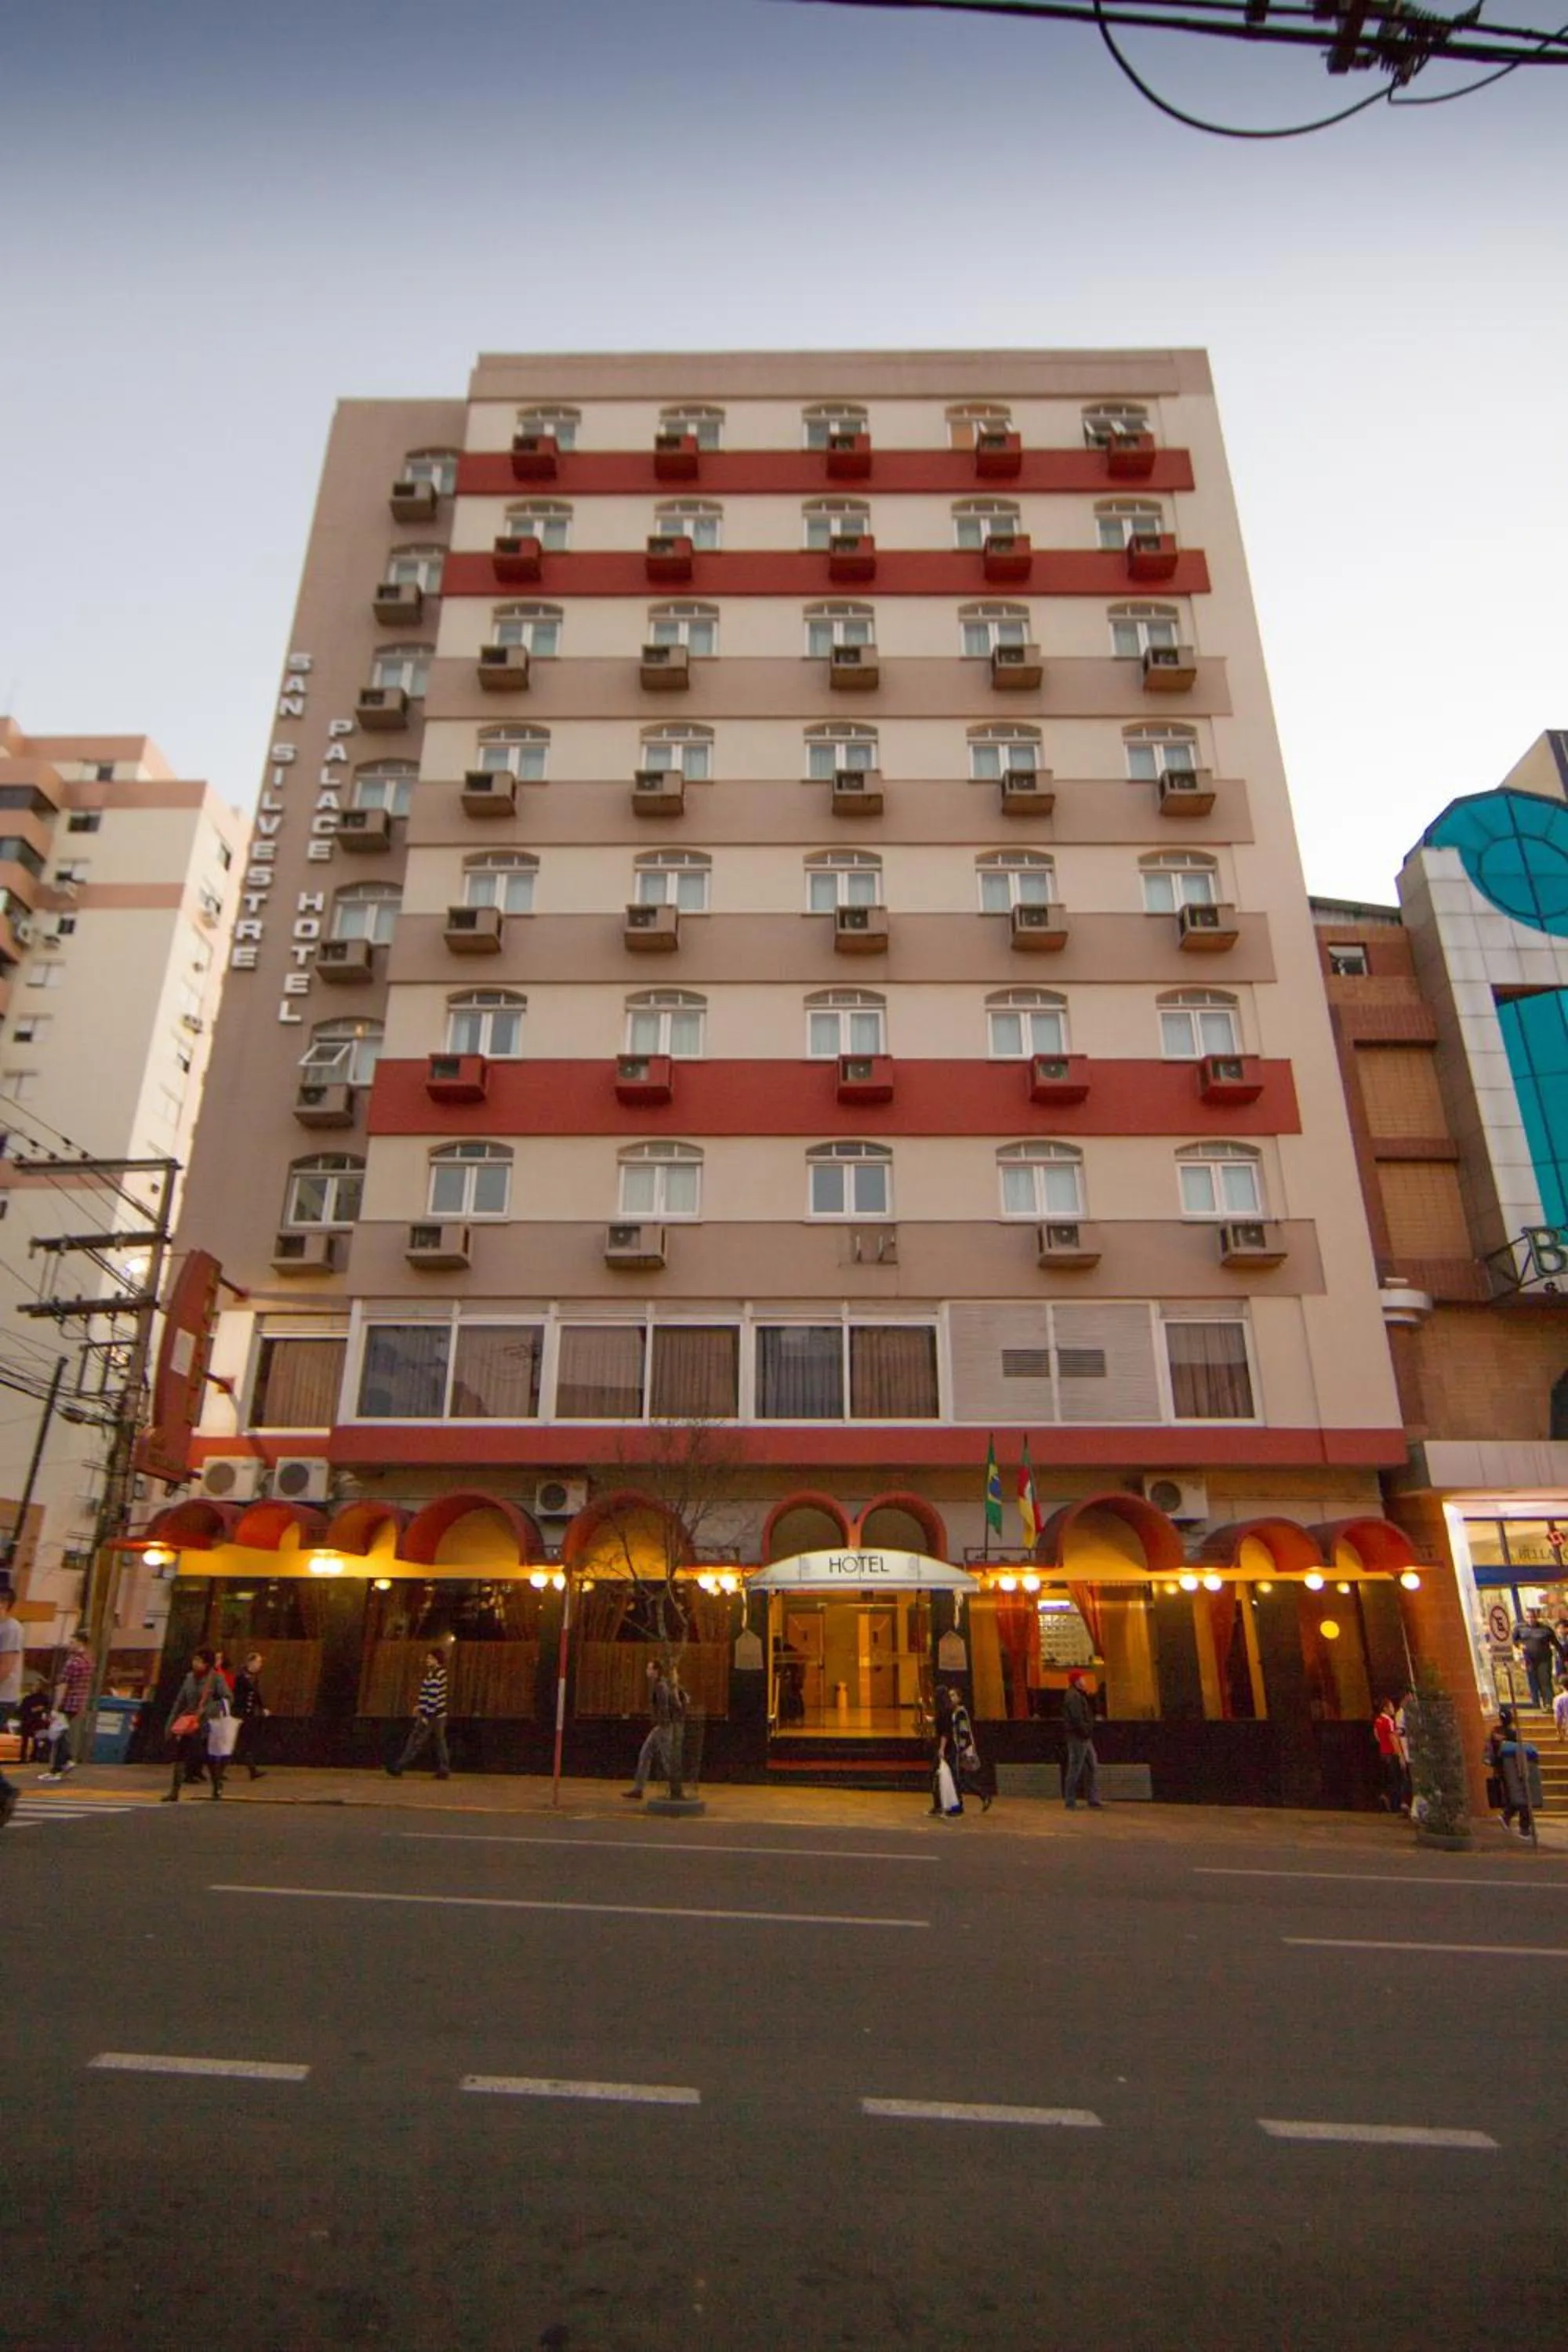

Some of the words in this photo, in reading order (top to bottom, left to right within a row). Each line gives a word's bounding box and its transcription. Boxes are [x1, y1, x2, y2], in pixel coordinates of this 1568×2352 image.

[279, 653, 312, 717] SAN
[307, 719, 354, 861] PALACE
[232, 743, 296, 969] SILVESTRE
[279, 892, 324, 1023] HOTEL
[829, 1555, 890, 1573] HOTEL
